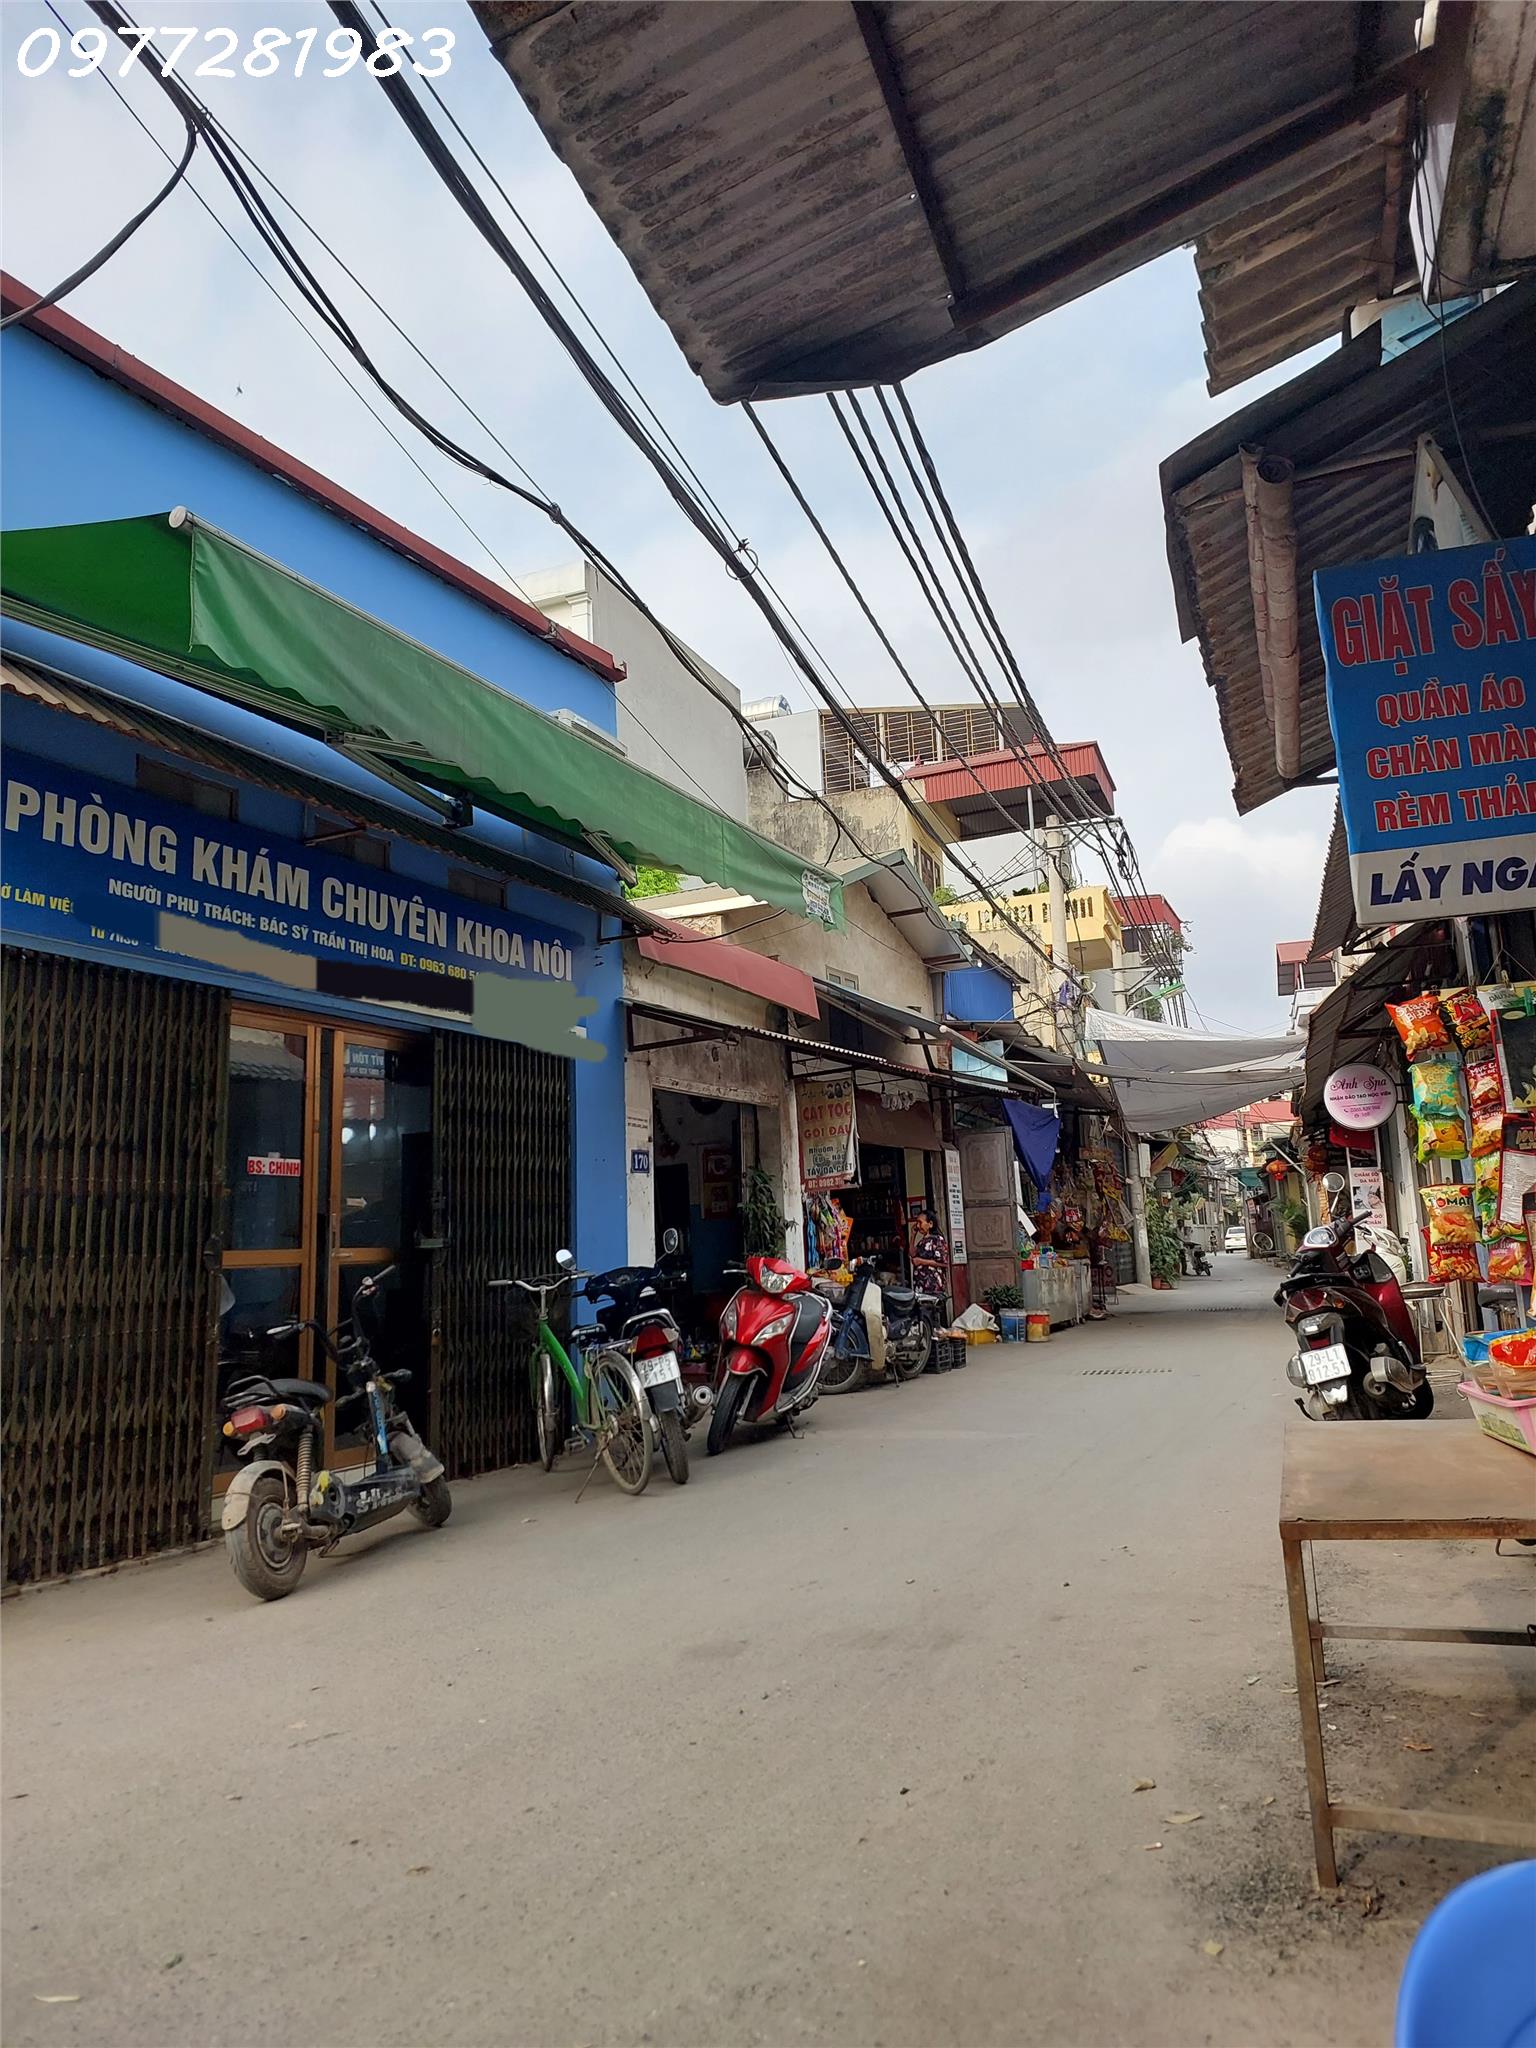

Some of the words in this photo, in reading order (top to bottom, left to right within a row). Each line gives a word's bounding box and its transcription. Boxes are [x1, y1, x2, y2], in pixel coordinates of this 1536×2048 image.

[1331, 574, 1436, 676] GIẶT
[1447, 547, 1536, 650] SẤY
[1376, 677, 1470, 729] QUẦN
[1479, 673, 1526, 712] ÁO
[1366, 735, 1461, 780] CHĂN
[1373, 791, 1453, 833] RÈM
[4, 780, 177, 875] PHÒNG
[192, 834, 309, 910] KHÁM
[322, 876, 447, 949] CHUYÊN
[456, 918, 526, 969] KHOA
[533, 938, 573, 983] NỘI
[1370, 851, 1452, 906] LẤY
[1461, 856, 1536, 896] NG
[15, 887, 46, 907] LÀM
[50, 896, 75, 915] VIỆ
[109, 878, 162, 906] NGƯỜI
[167, 892, 199, 918] PHỤ
[203, 902, 256, 928] TRÁCH:
[259, 916, 288, 936] BÁC
[292, 923, 308, 941] SỸ
[349, 938, 368, 959] THỊ
[371, 944, 395, 962] HOA
[419, 957, 446, 975] 0963
[447, 965, 467, 980] 680
[1363, 1076, 1387, 1091] Spa
[248, 1160, 265, 1174] BS:
[634, 1154, 649, 1169] 170
[1308, 1347, 1340, 1368] 29-L1
[1308, 1360, 1347, 1381] 812.51
